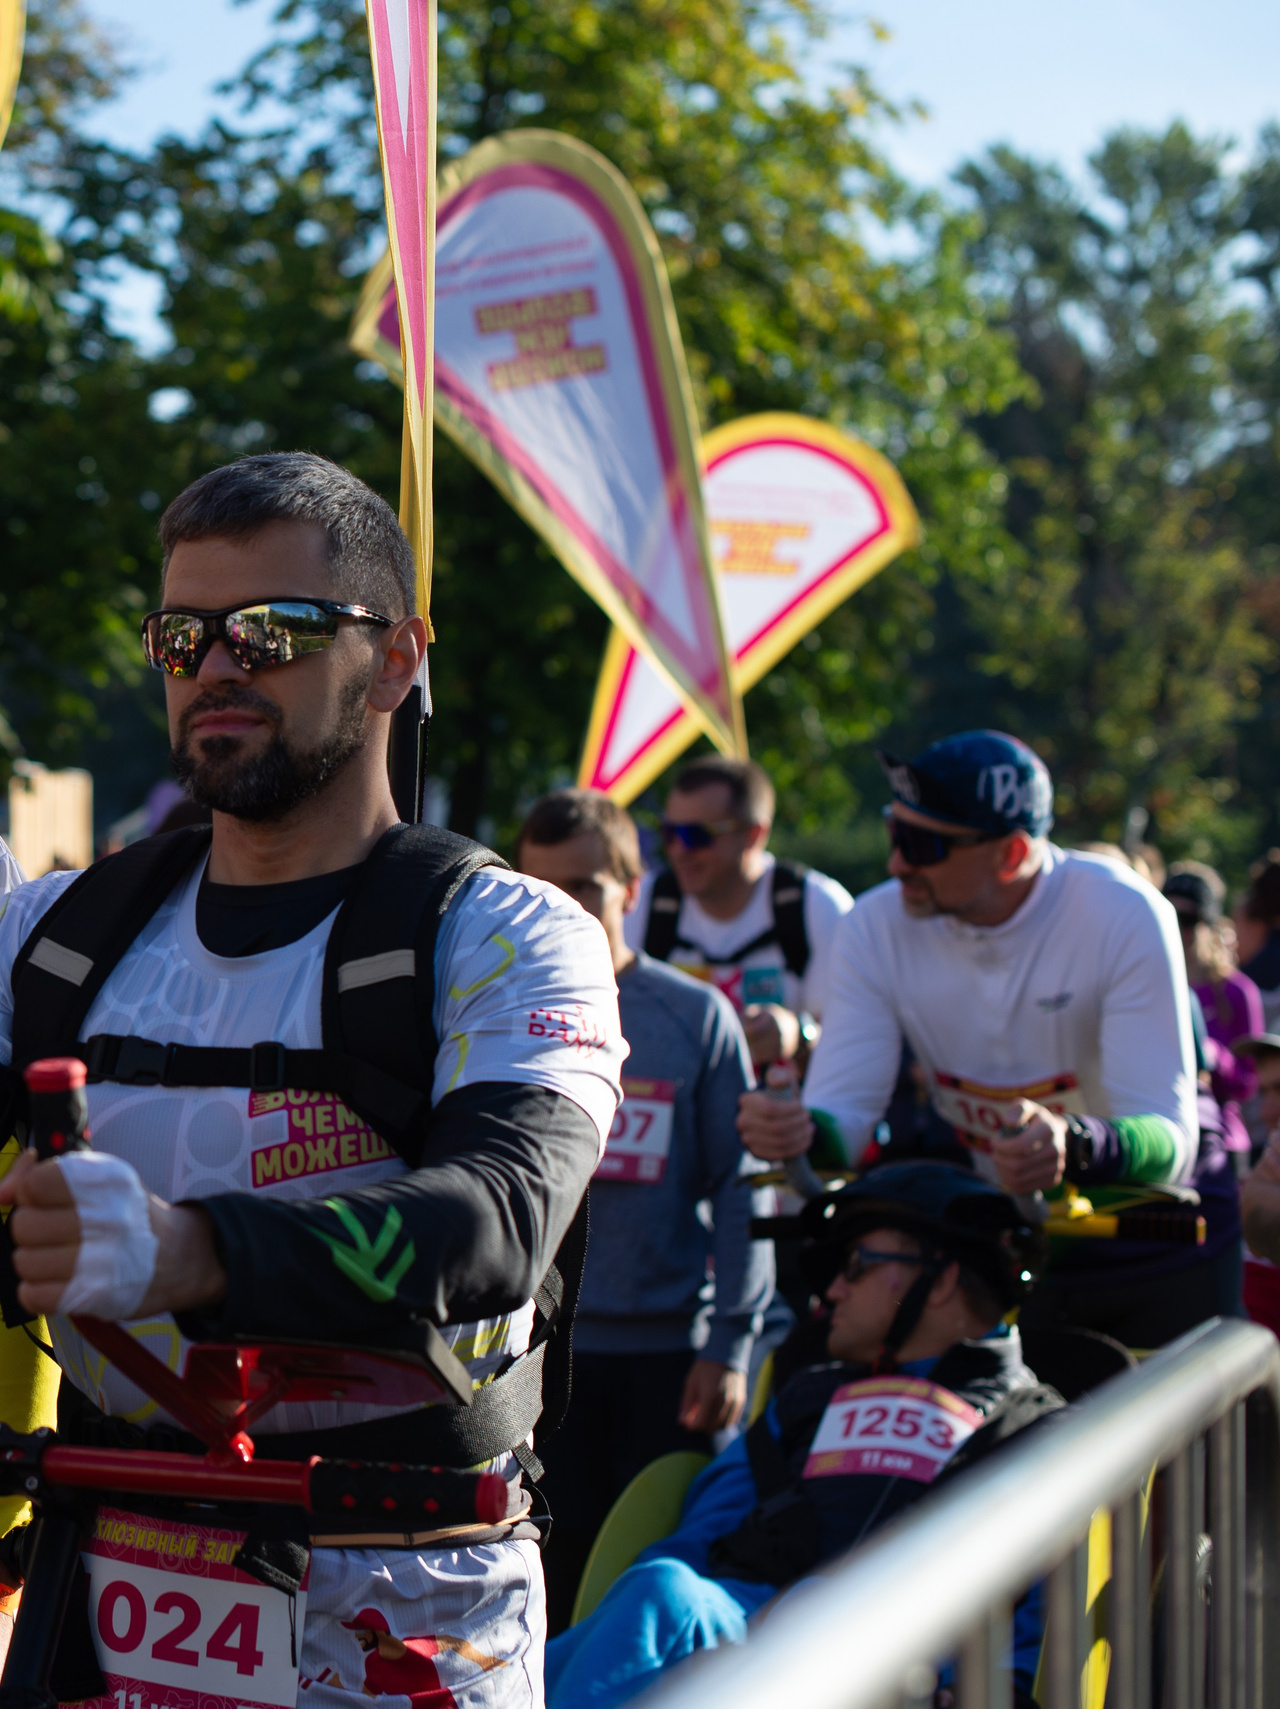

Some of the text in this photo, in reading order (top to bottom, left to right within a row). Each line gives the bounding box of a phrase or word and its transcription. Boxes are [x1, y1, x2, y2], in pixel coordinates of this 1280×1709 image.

[291, 1103, 365, 1136] ЧЕМ
[255, 1131, 400, 1185] МОЖЕШ
[842, 1406, 955, 1450] 1253
[86, 1573, 264, 1677] 024
